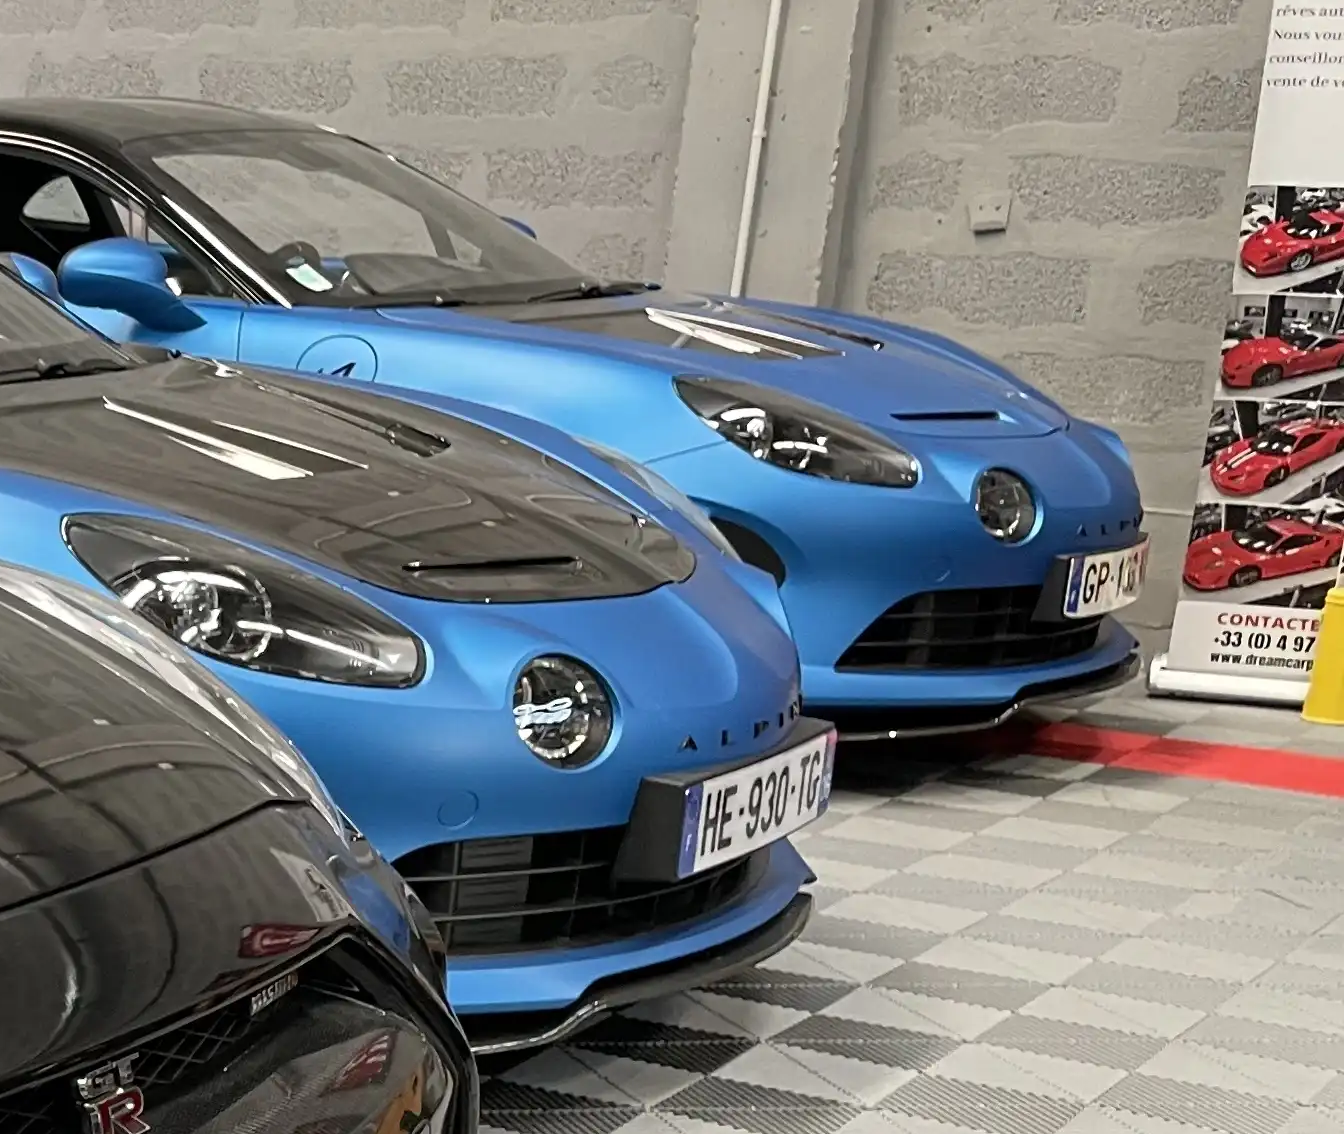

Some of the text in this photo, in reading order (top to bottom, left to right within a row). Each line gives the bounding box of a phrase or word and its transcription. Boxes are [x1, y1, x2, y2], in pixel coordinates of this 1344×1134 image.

[1273, 29, 1310, 40] Nous
[1311, 76, 1329, 87] de
[1248, 632, 1272, 650] (0)
[1276, 634, 1288, 651] 4
[1292, 635, 1317, 653] 97
[700, 749, 821, 857] HE-930-TG
